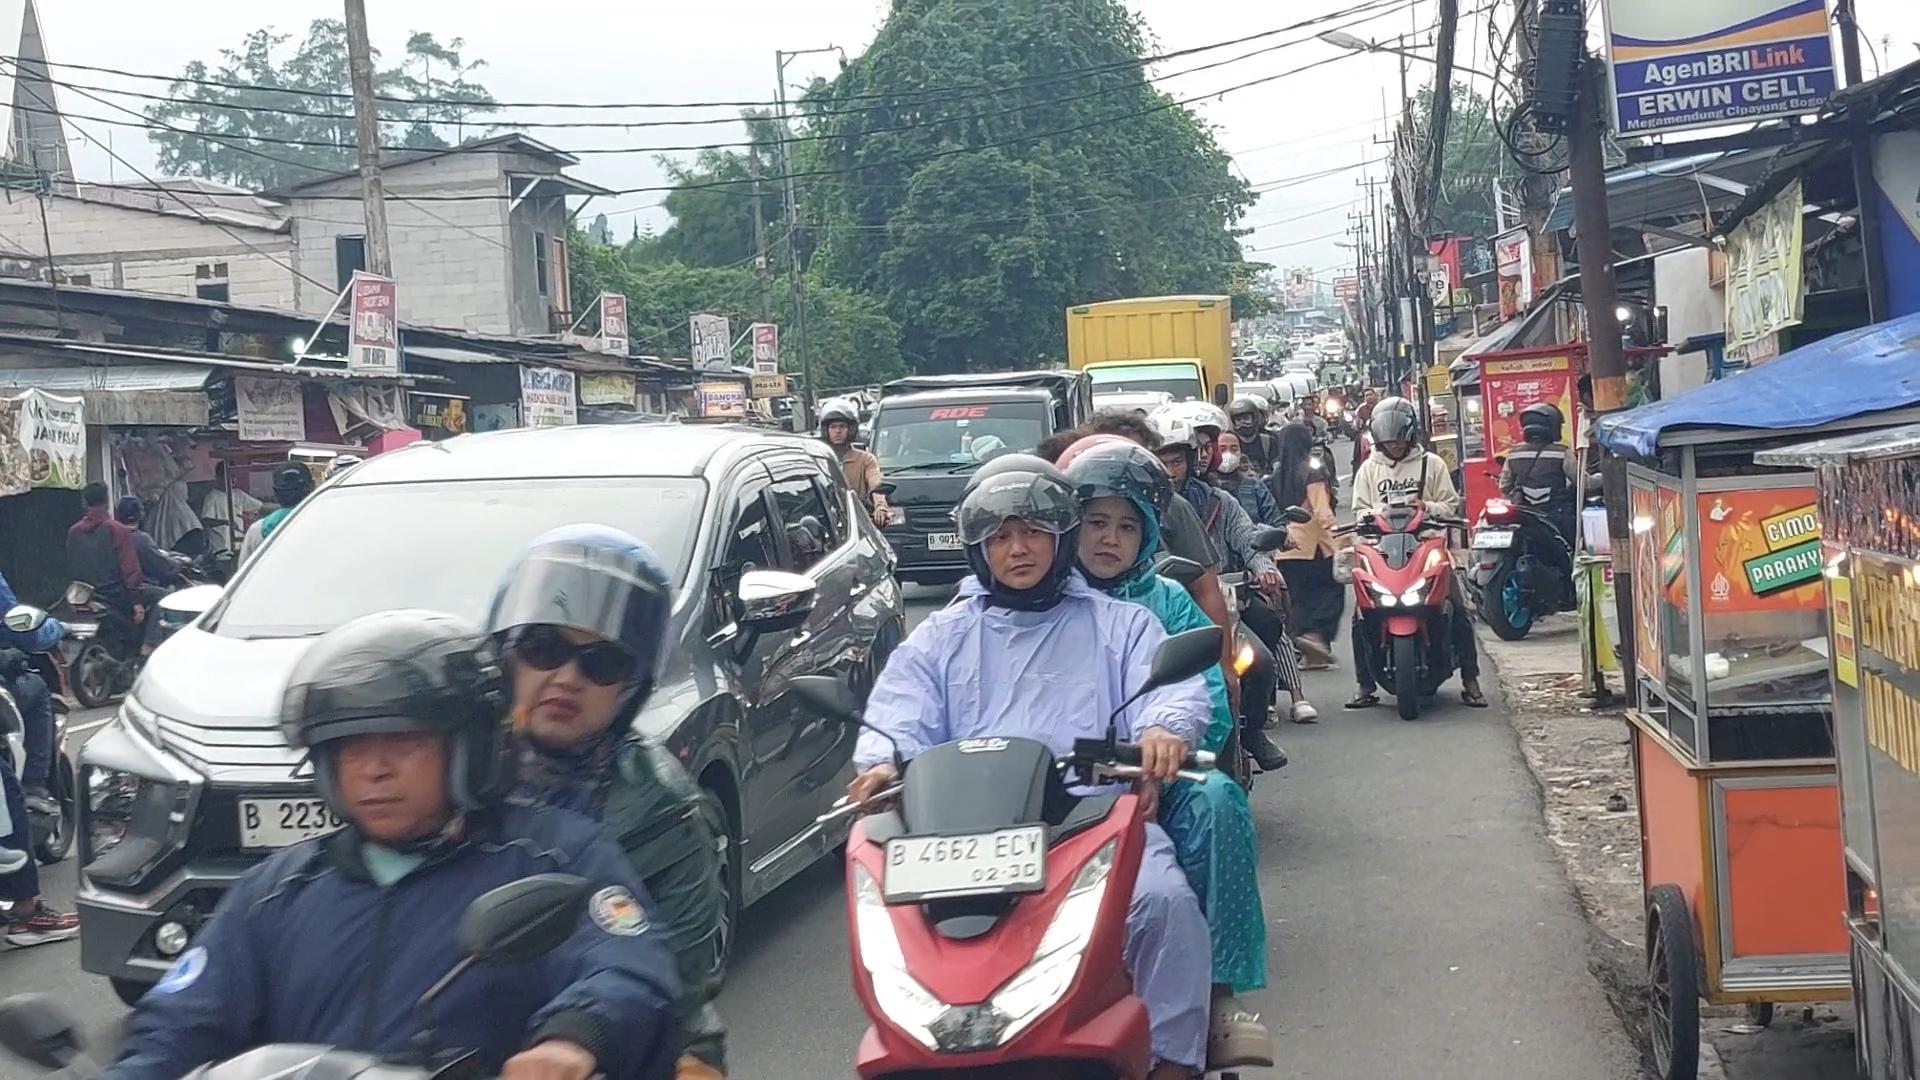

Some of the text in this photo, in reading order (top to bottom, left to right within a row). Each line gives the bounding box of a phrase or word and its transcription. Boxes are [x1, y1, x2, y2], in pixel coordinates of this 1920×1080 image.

[1644, 44, 1805, 85] AgenBRILink
[1637, 76, 1815, 116] ERWIN CELL
[1627, 109, 1724, 130] Megamendung
[1726, 101, 1788, 118] Cipayung
[1767, 511, 1819, 542] CIMO
[244, 803, 261, 830] B
[892, 844, 906, 866] B
[918, 838, 979, 863] 4662
